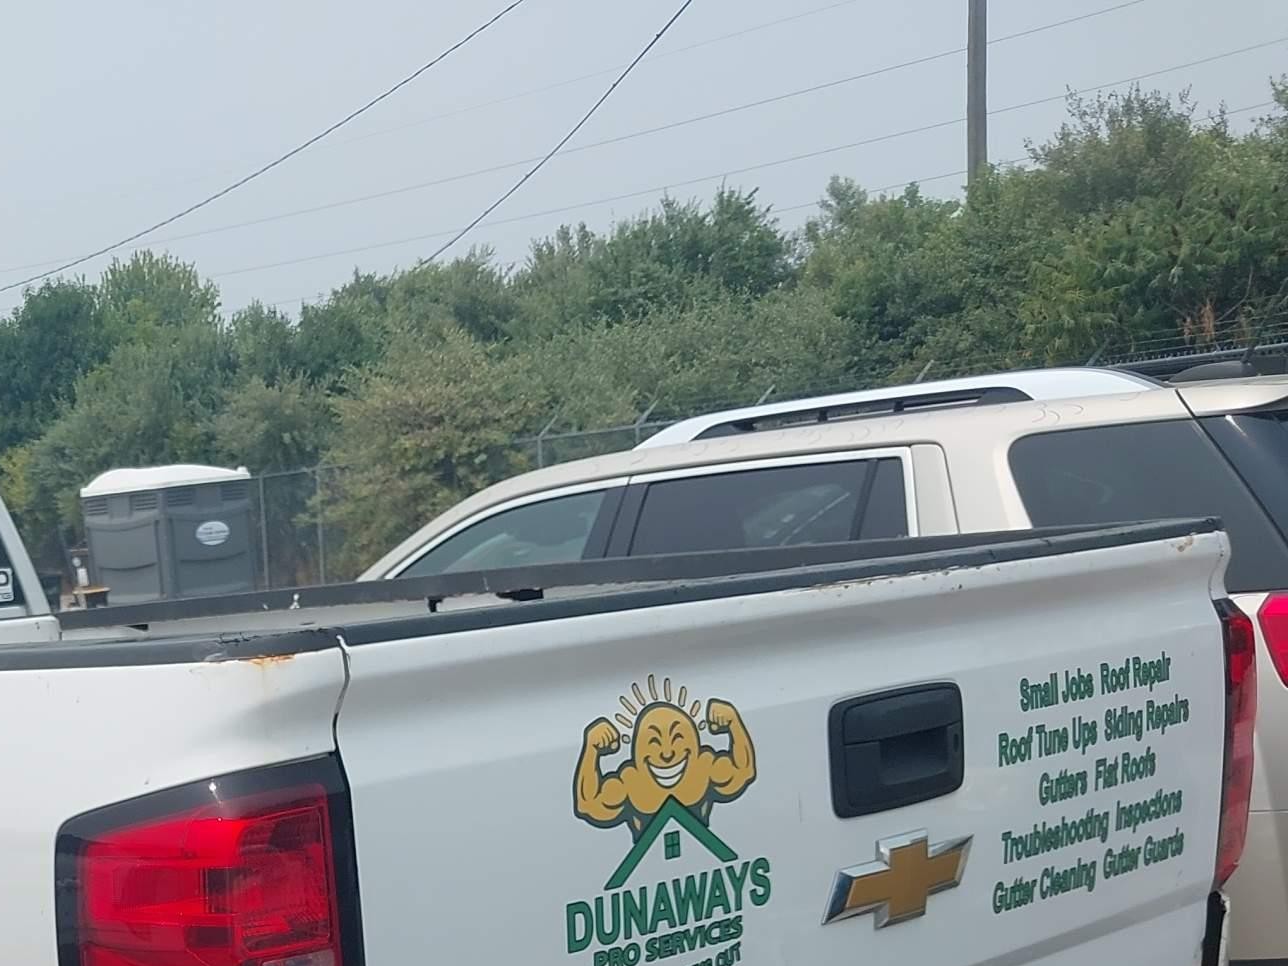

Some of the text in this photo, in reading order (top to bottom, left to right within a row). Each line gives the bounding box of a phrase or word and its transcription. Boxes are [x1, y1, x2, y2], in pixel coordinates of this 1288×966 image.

[1019, 651, 1171, 712] Small Jobs Roof Repair
[998, 693, 1189, 767] Roof Tune Ups Siding Repairs
[1039, 746, 1156, 806] Gutters Flat Roofs
[1001, 788, 1183, 864] Troubleshooting Inspections
[566, 857, 772, 954] DUNAWAYS
[992, 827, 1184, 914] Gutter Cleaning Gutter Guards
[645, 915, 743, 962] SERVICES
